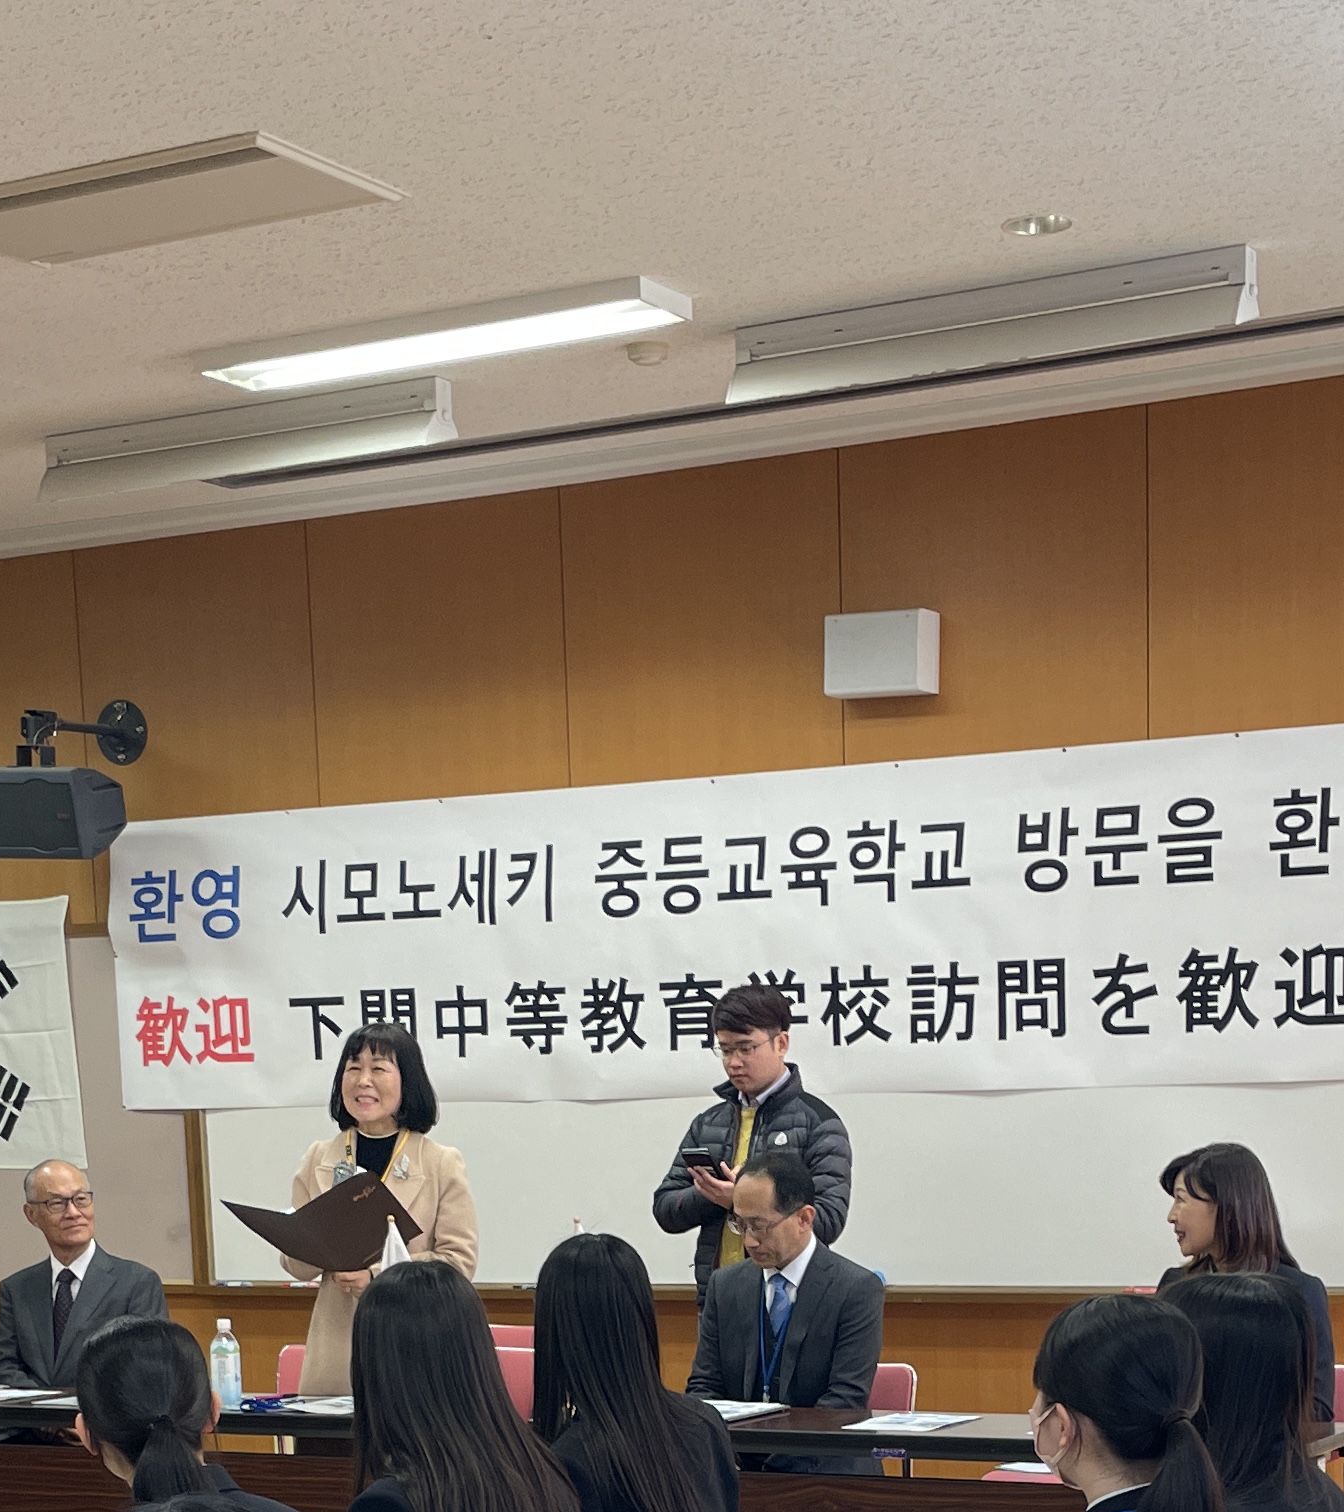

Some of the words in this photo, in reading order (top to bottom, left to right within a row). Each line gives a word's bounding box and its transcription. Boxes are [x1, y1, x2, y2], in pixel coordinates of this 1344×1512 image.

[128, 864, 242, 943] 환영
[281, 843, 554, 935] 시모노세키
[593, 819, 971, 919] 중등교육학교
[1017, 797, 1224, 893] 방문을
[135, 995, 256, 1068] 歓迎
